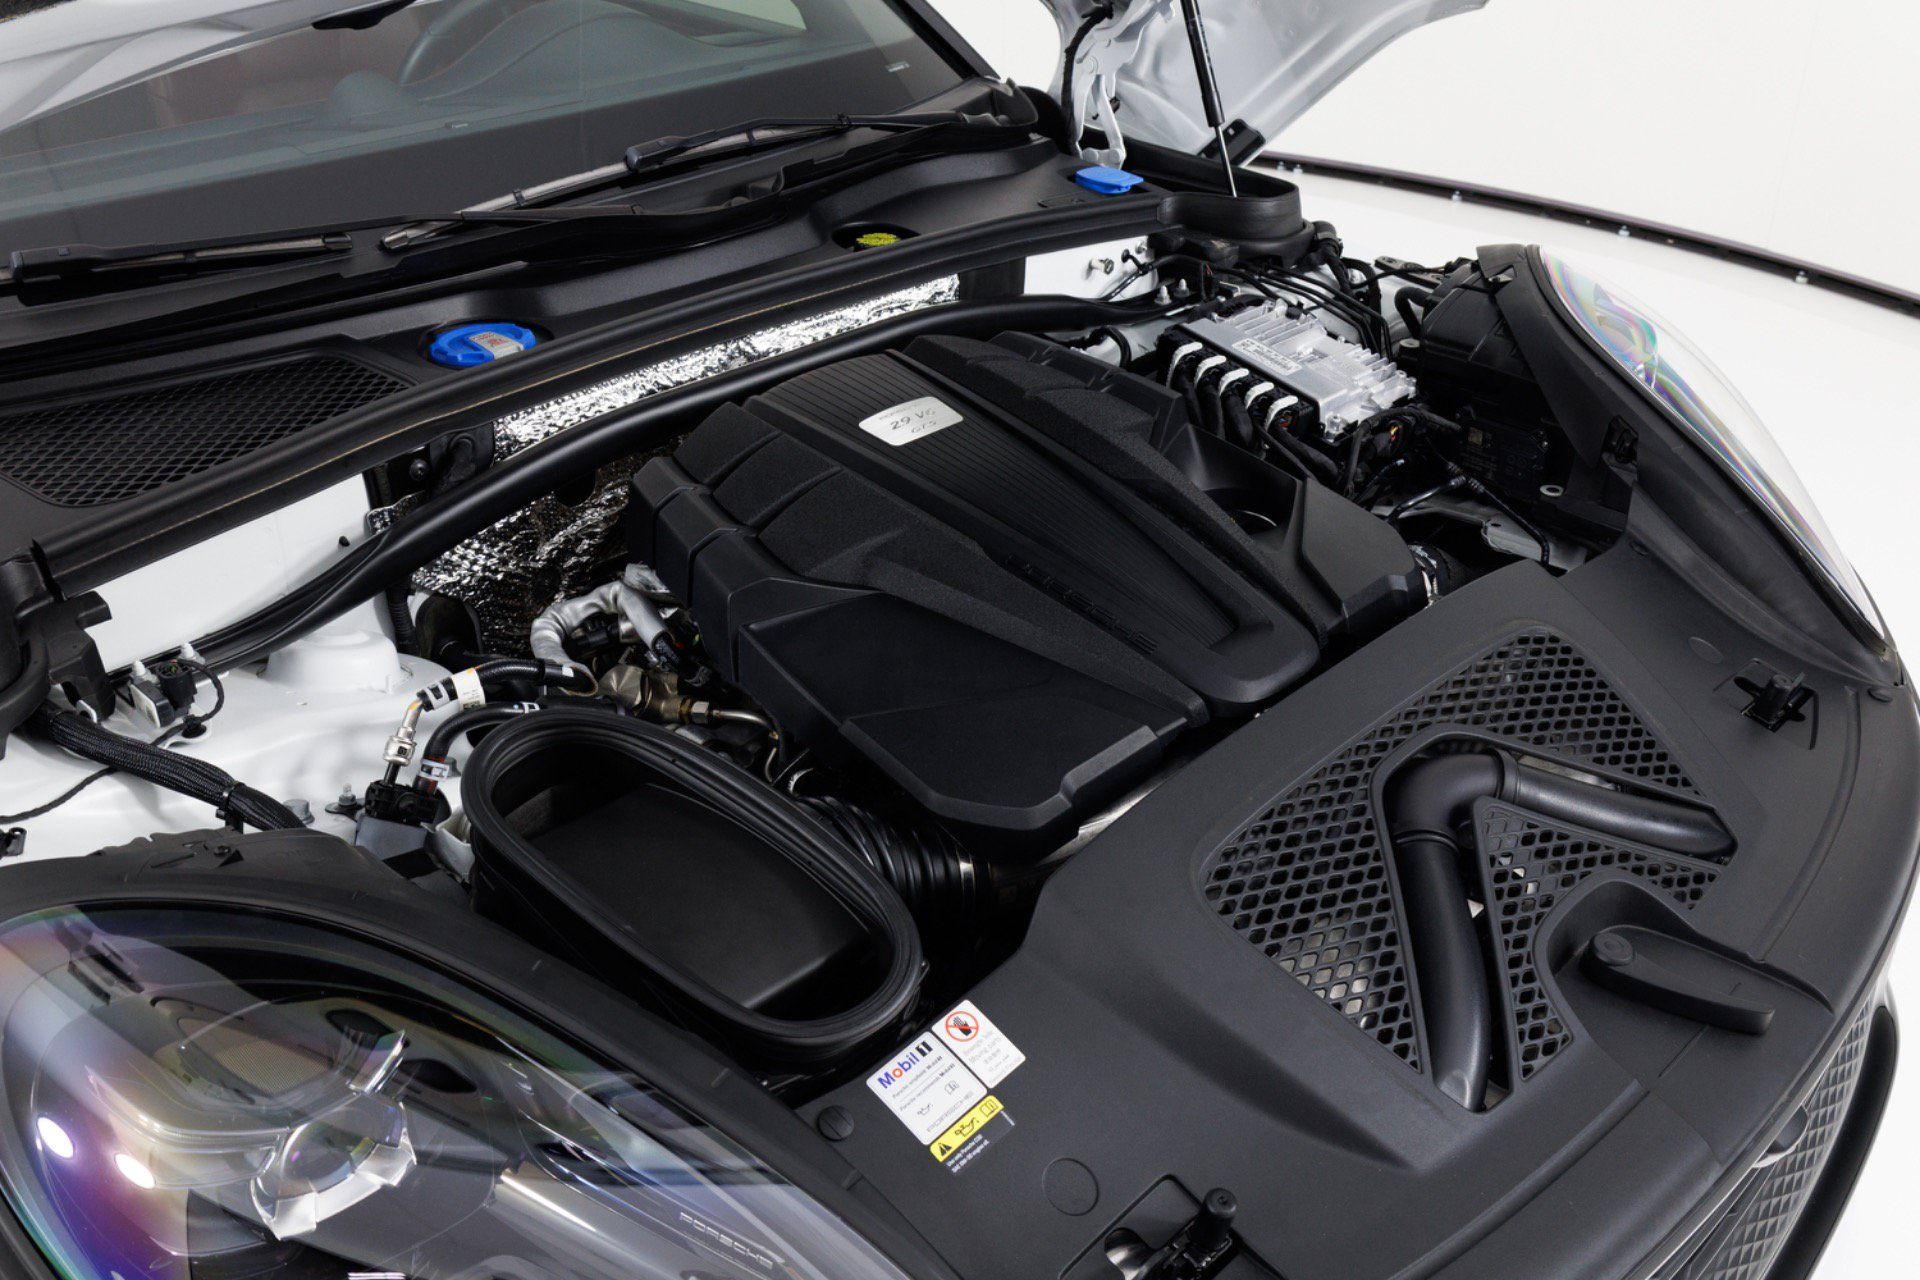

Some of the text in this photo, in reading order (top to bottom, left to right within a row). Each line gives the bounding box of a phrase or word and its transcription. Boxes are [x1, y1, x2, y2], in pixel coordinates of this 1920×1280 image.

[1005, 553, 1160, 655] PORSCHE
[877, 1051, 920, 1089] Mobil
[679, 1211, 774, 1270] PORSCHE
